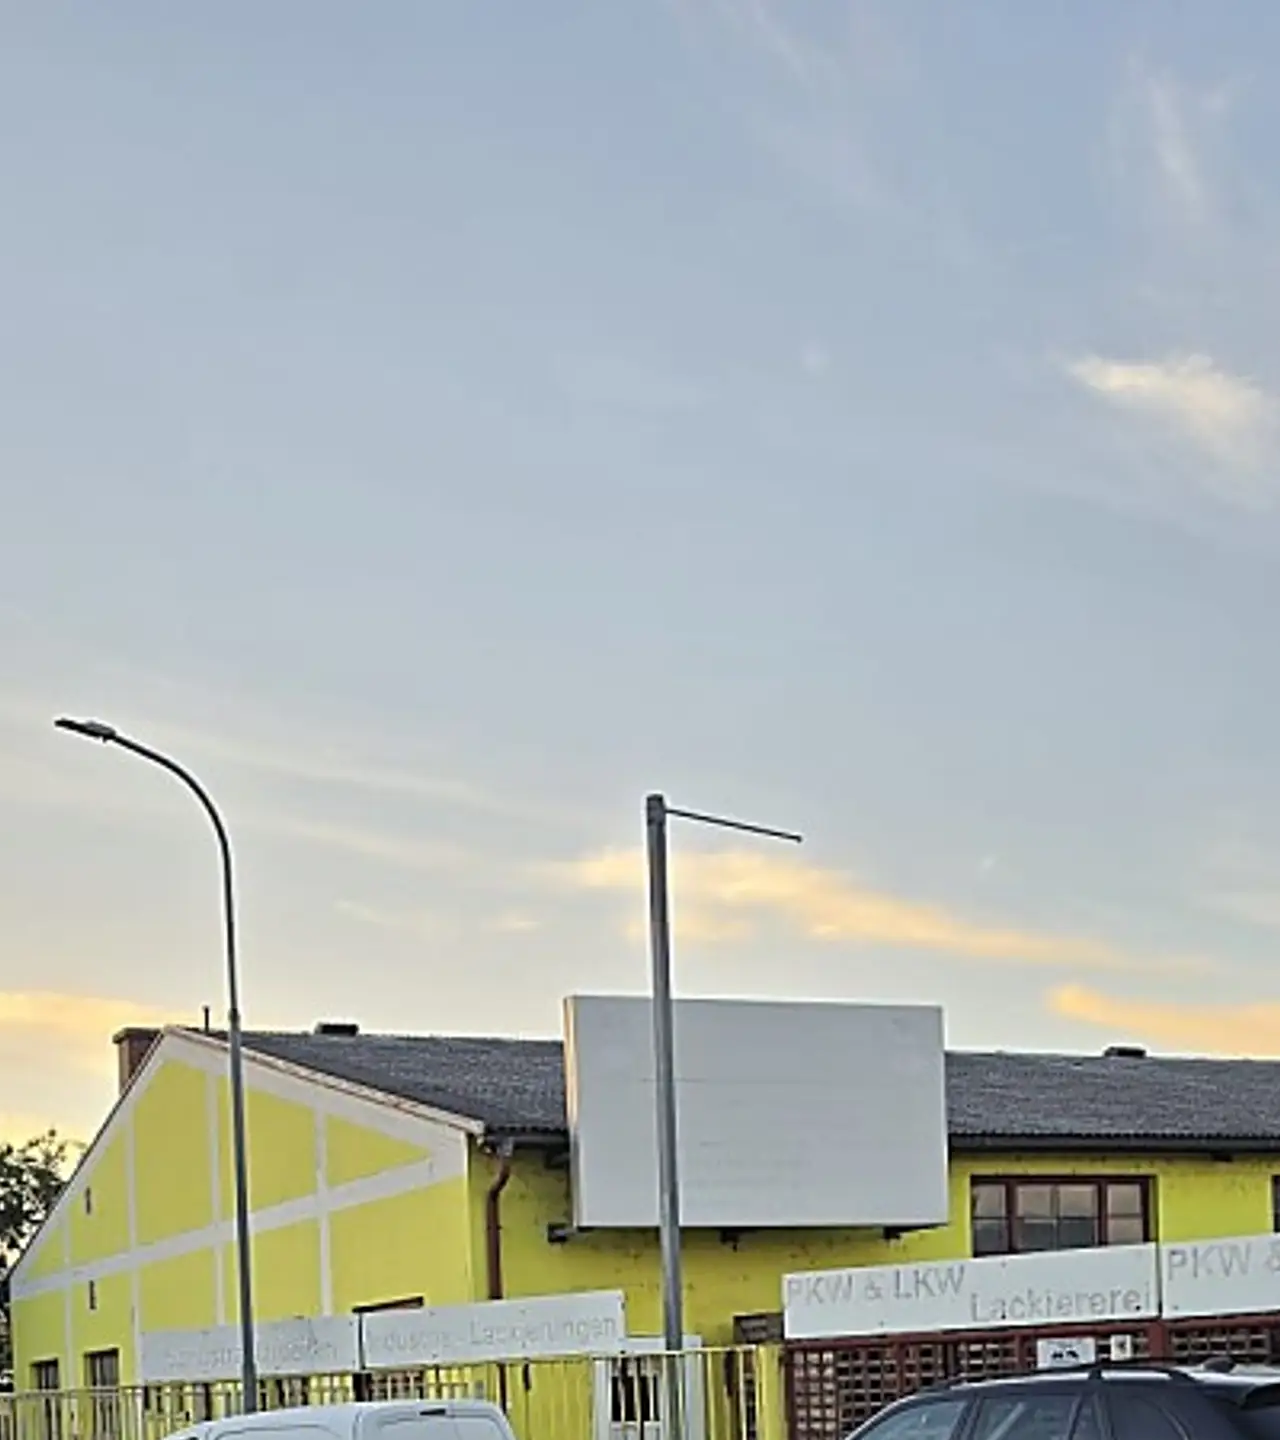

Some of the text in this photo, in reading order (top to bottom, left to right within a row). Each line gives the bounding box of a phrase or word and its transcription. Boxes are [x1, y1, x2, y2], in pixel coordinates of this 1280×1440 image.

[786, 1263, 967, 1307] PKW & LKW
[1166, 1244, 1253, 1282] PKW
[970, 1280, 1152, 1324] Lackiererei
